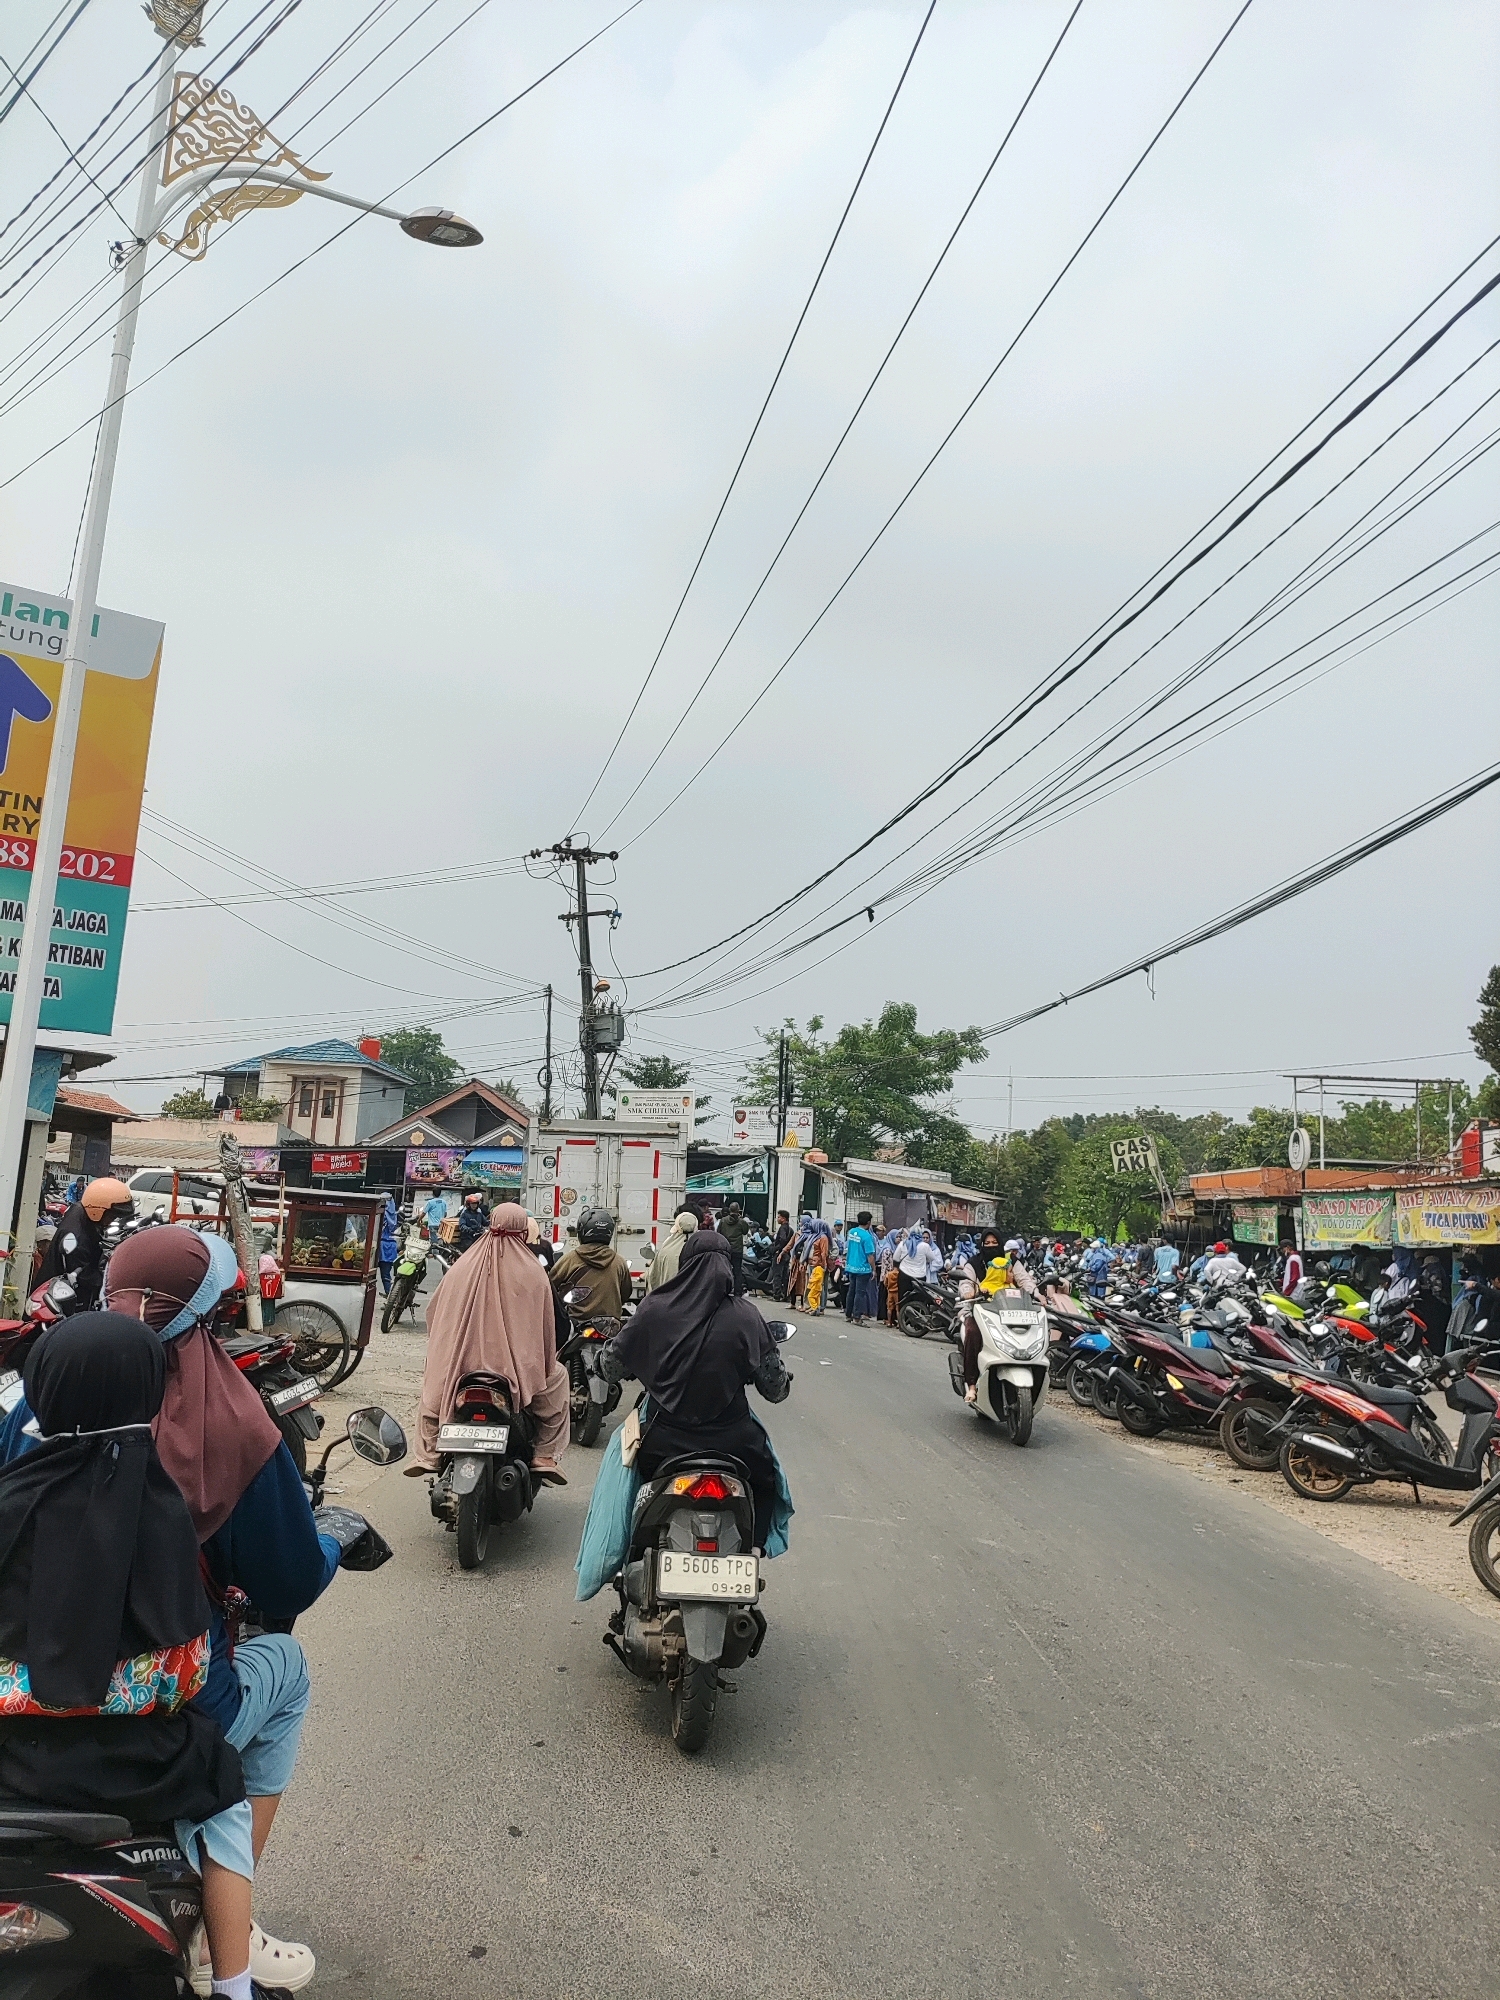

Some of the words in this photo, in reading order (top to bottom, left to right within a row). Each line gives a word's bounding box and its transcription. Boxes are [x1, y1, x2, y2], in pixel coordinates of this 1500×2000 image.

[67, 911, 107, 934] JAGA
[1113, 1136, 1151, 1157] CAS
[1117, 1153, 1150, 1172] AKI
[1427, 1186, 1474, 1208] AYAM
[273, 1396, 280, 1405] B
[443, 1427, 449, 1437] B
[454, 1427, 480, 1438] 3296
[486, 1428, 505, 1439] TSM
[664, 1556, 672, 1573] B
[682, 1557, 719, 1574] 5606
[726, 1559, 753, 1577] TPC
[115, 1847, 182, 1864] VARIO
[80, 1884, 118, 1912] ABSOLUTE
[118, 1911, 137, 1928] MATIC
